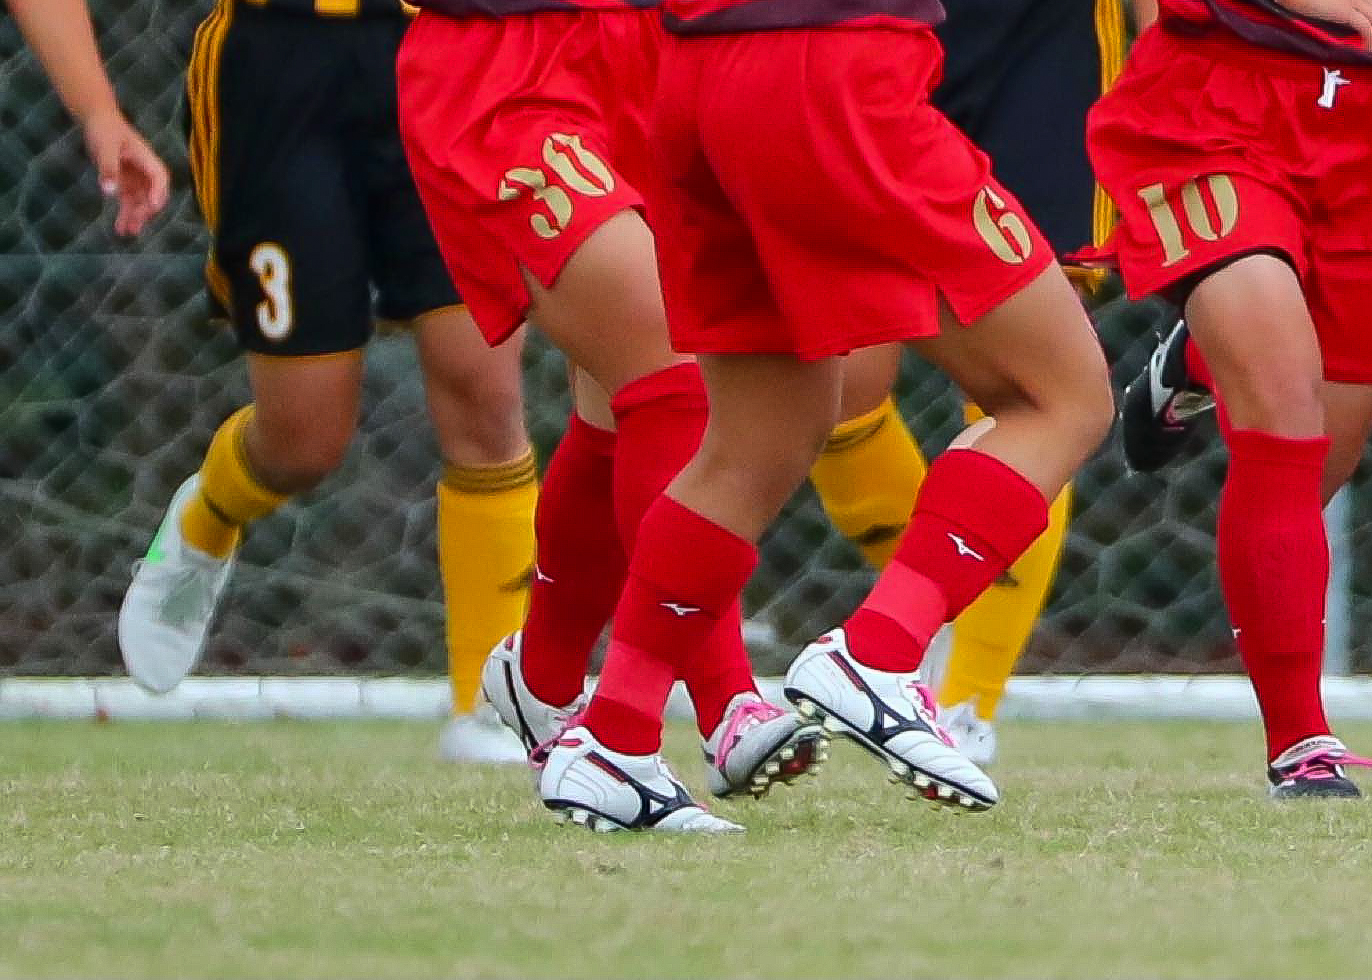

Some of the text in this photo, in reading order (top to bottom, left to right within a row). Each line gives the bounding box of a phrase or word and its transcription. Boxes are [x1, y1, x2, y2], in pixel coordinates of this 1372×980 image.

[499, 131, 616, 239] 30
[972, 185, 1033, 265] 6
[1137, 173, 1240, 269] 10
[249, 241, 295, 343] 3
